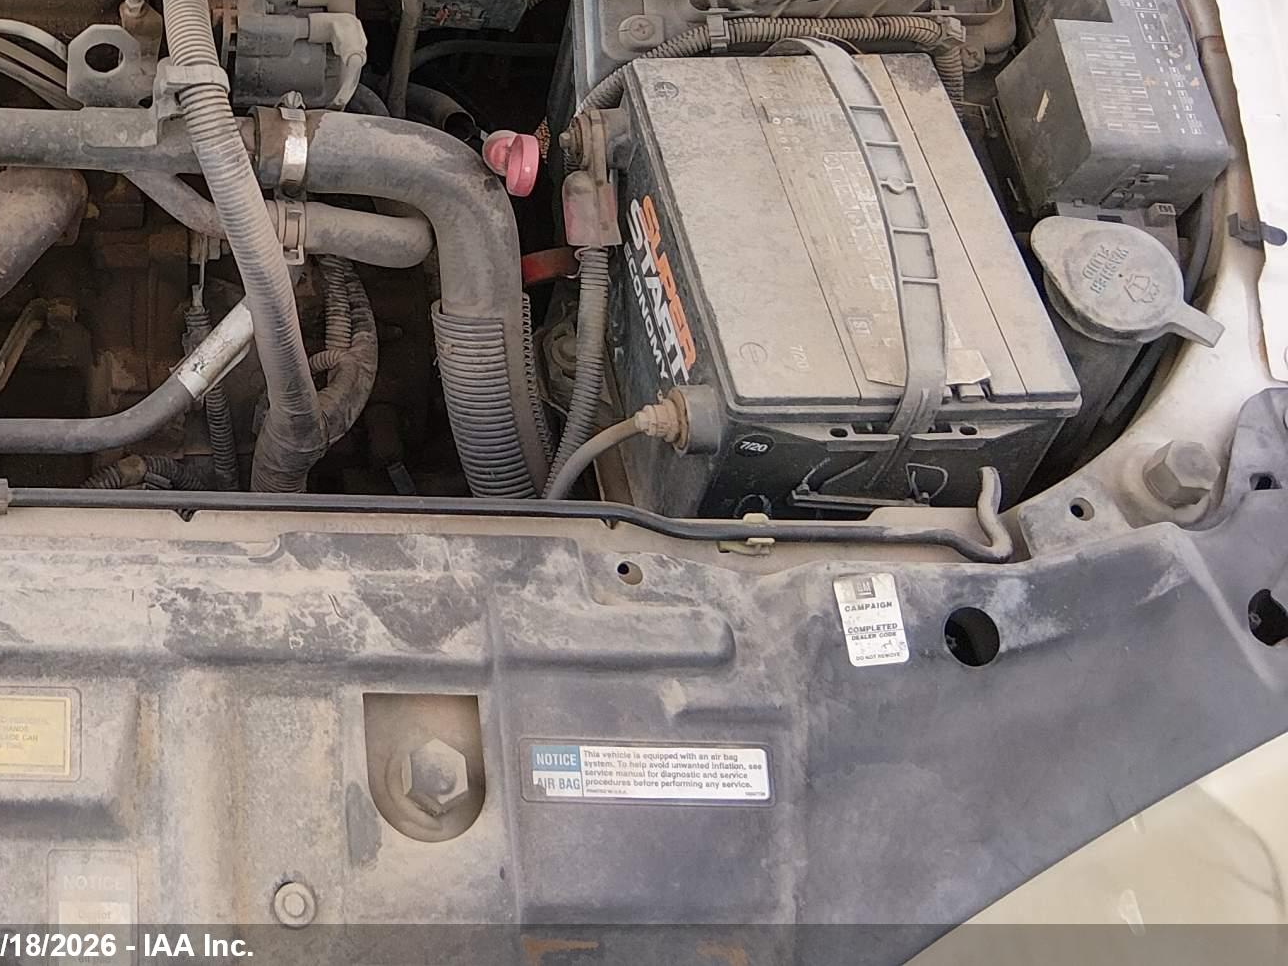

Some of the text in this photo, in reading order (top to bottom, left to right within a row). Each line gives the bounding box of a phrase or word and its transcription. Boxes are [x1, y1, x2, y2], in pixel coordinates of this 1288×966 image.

[638, 195, 697, 371] SUPER
[626, 198, 689, 383] START
[623, 241, 669, 380] ECONOMY
[739, 440, 768, 454] 7/20
[844, 602, 892, 612] CAMPAIGN
[848, 623, 898, 633] COMPLETED
[536, 753, 577, 766] NOTICE
[584, 751, 601, 759] This
[602, 751, 632, 760] vehicle
[633, 751, 641, 760] is
[642, 752, 684, 762] equipped
[685, 752, 698, 760] with
[710, 753, 722, 761] air
[723, 753, 738, 763] bag
[584, 761, 616, 771] system.
[617, 761, 628, 769] To
[629, 761, 647, 770] help
[649, 762, 669, 770] avoid
[671, 762, 710, 771] unwanted
[711, 762, 747, 772] inflation,
[584, 770, 748, 781] service manual for diagnostic and service
[537, 778, 581, 790] AIR BAG
[585, 778, 753, 790] procedures before performing any service.
[63, 875, 126, 891] NOTICE
